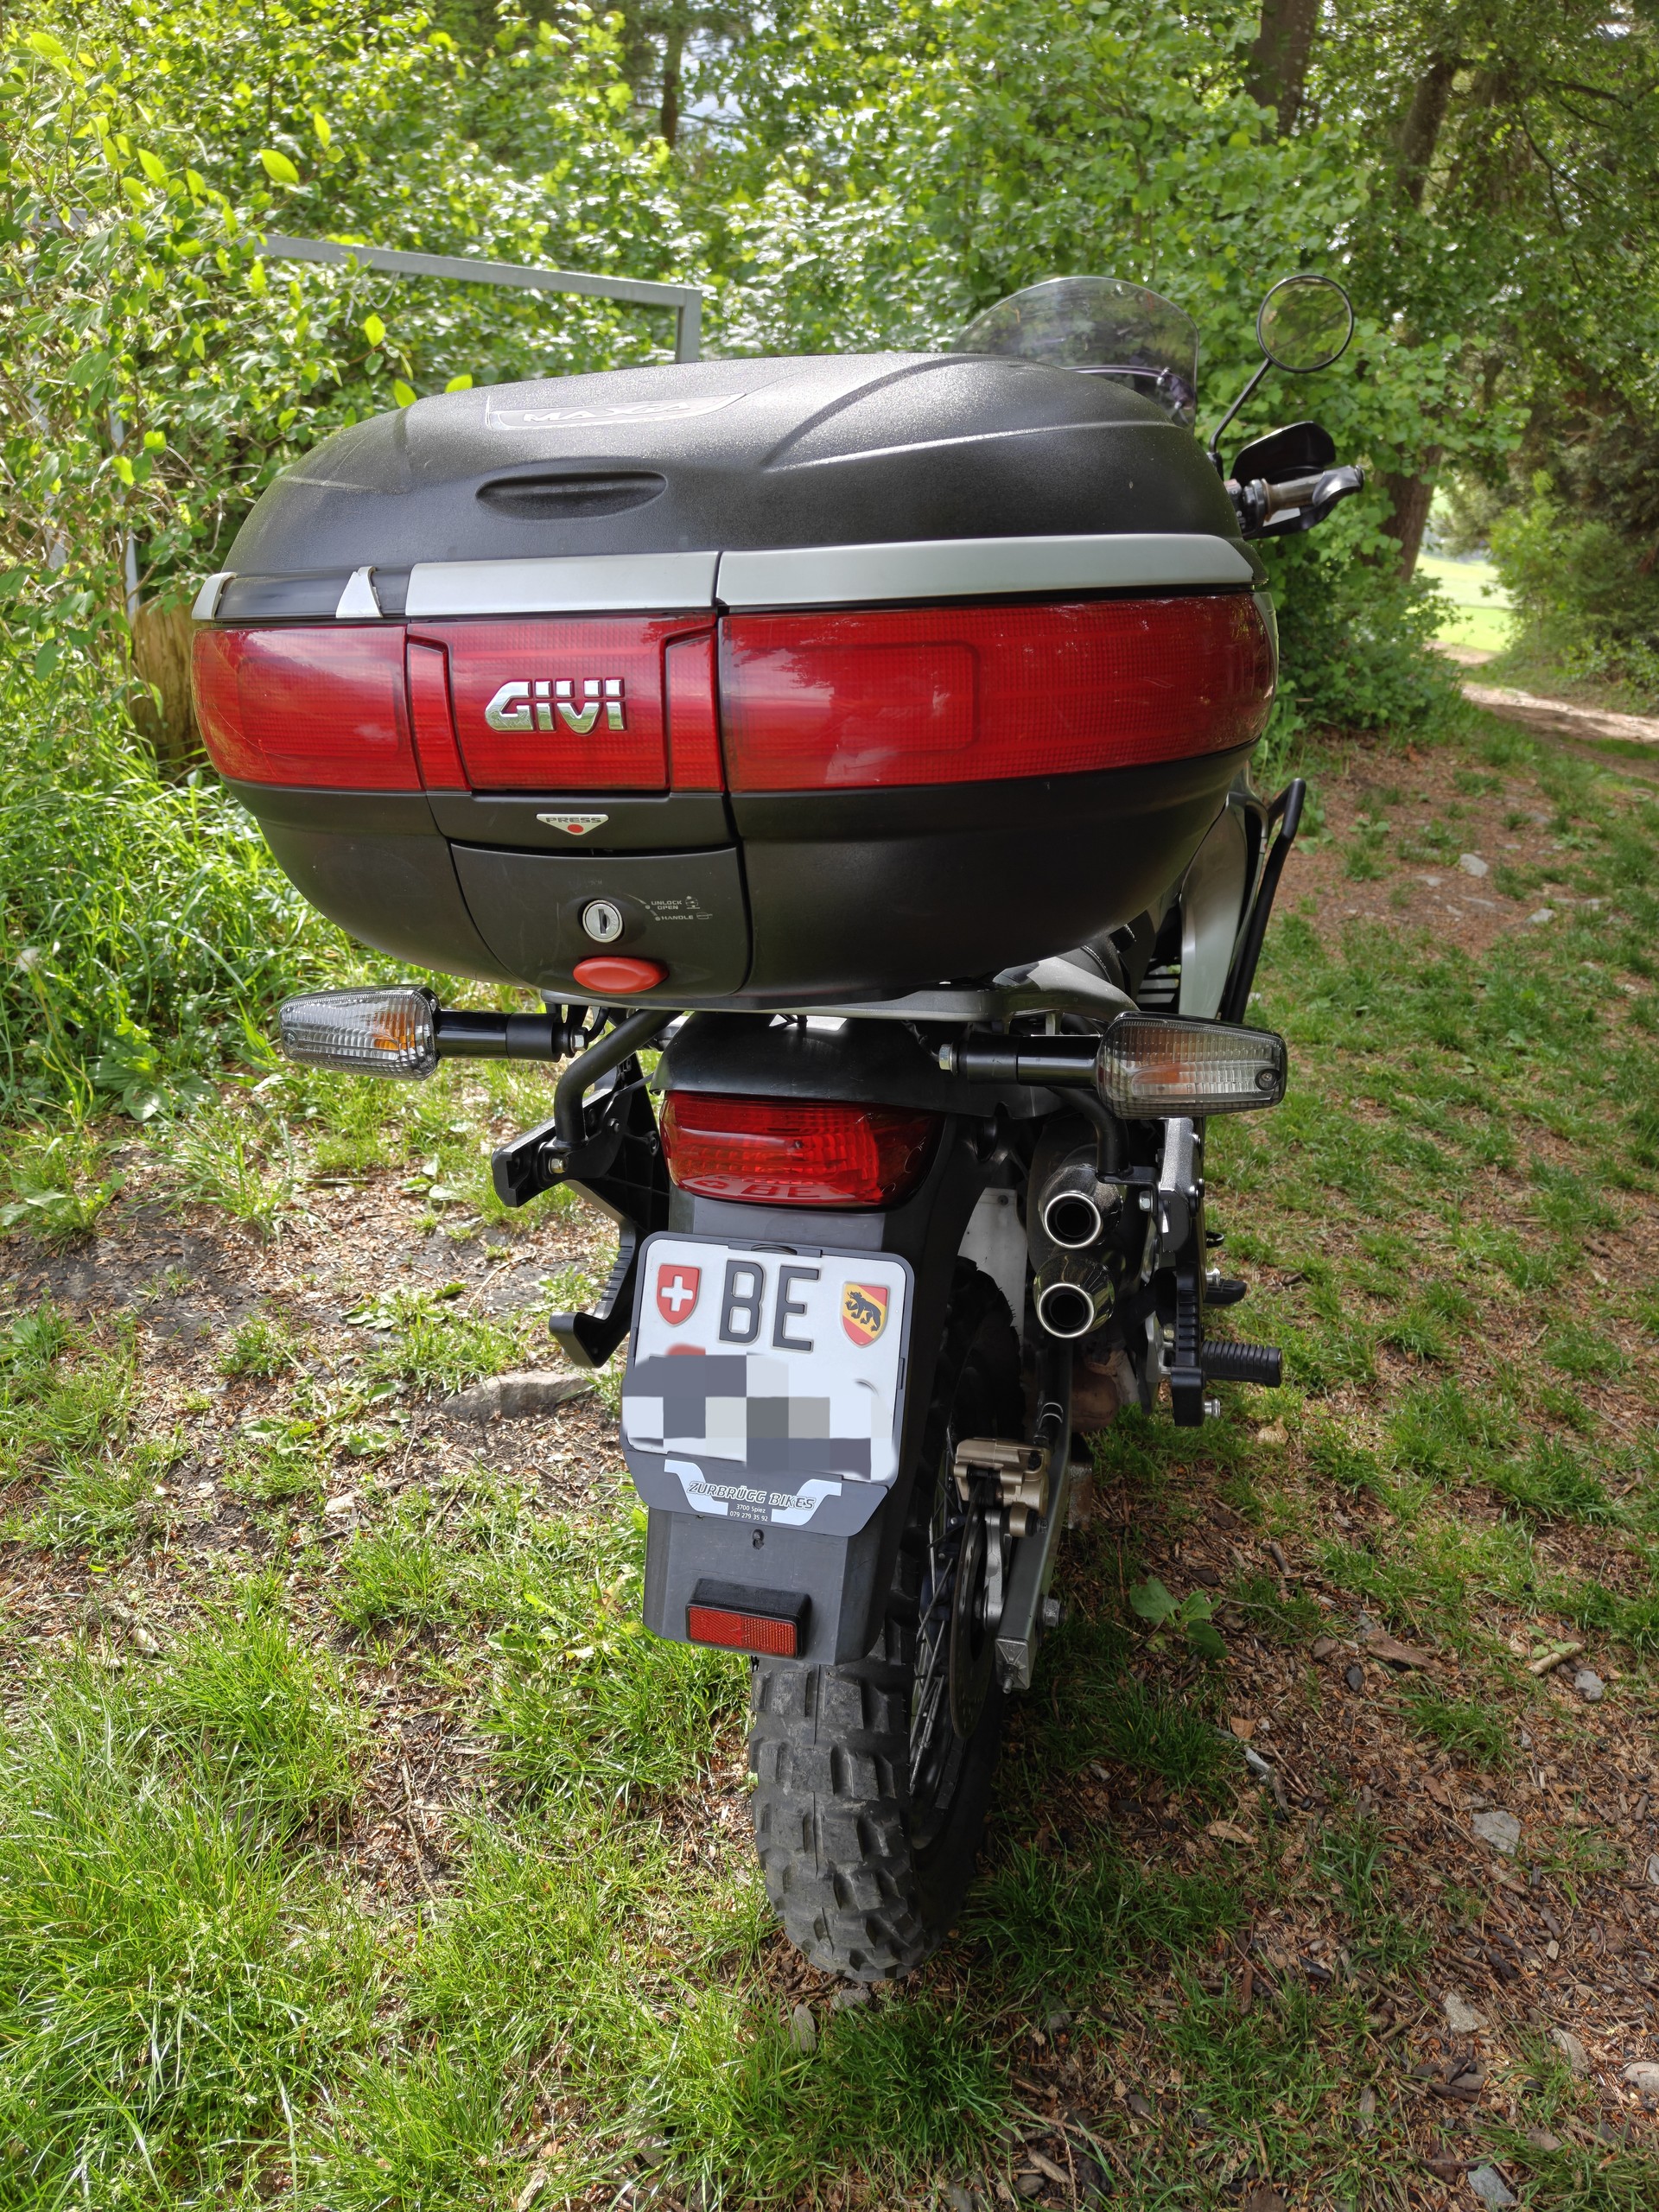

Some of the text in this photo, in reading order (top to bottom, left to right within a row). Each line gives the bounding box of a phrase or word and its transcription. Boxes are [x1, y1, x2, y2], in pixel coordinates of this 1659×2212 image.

[485, 679, 626, 734] GIVI
[718, 1259, 821, 1353] BE
[688, 1481, 817, 1510] ZURBRÜGG BIKES
[751, 1505, 766, 1514] Spiez
